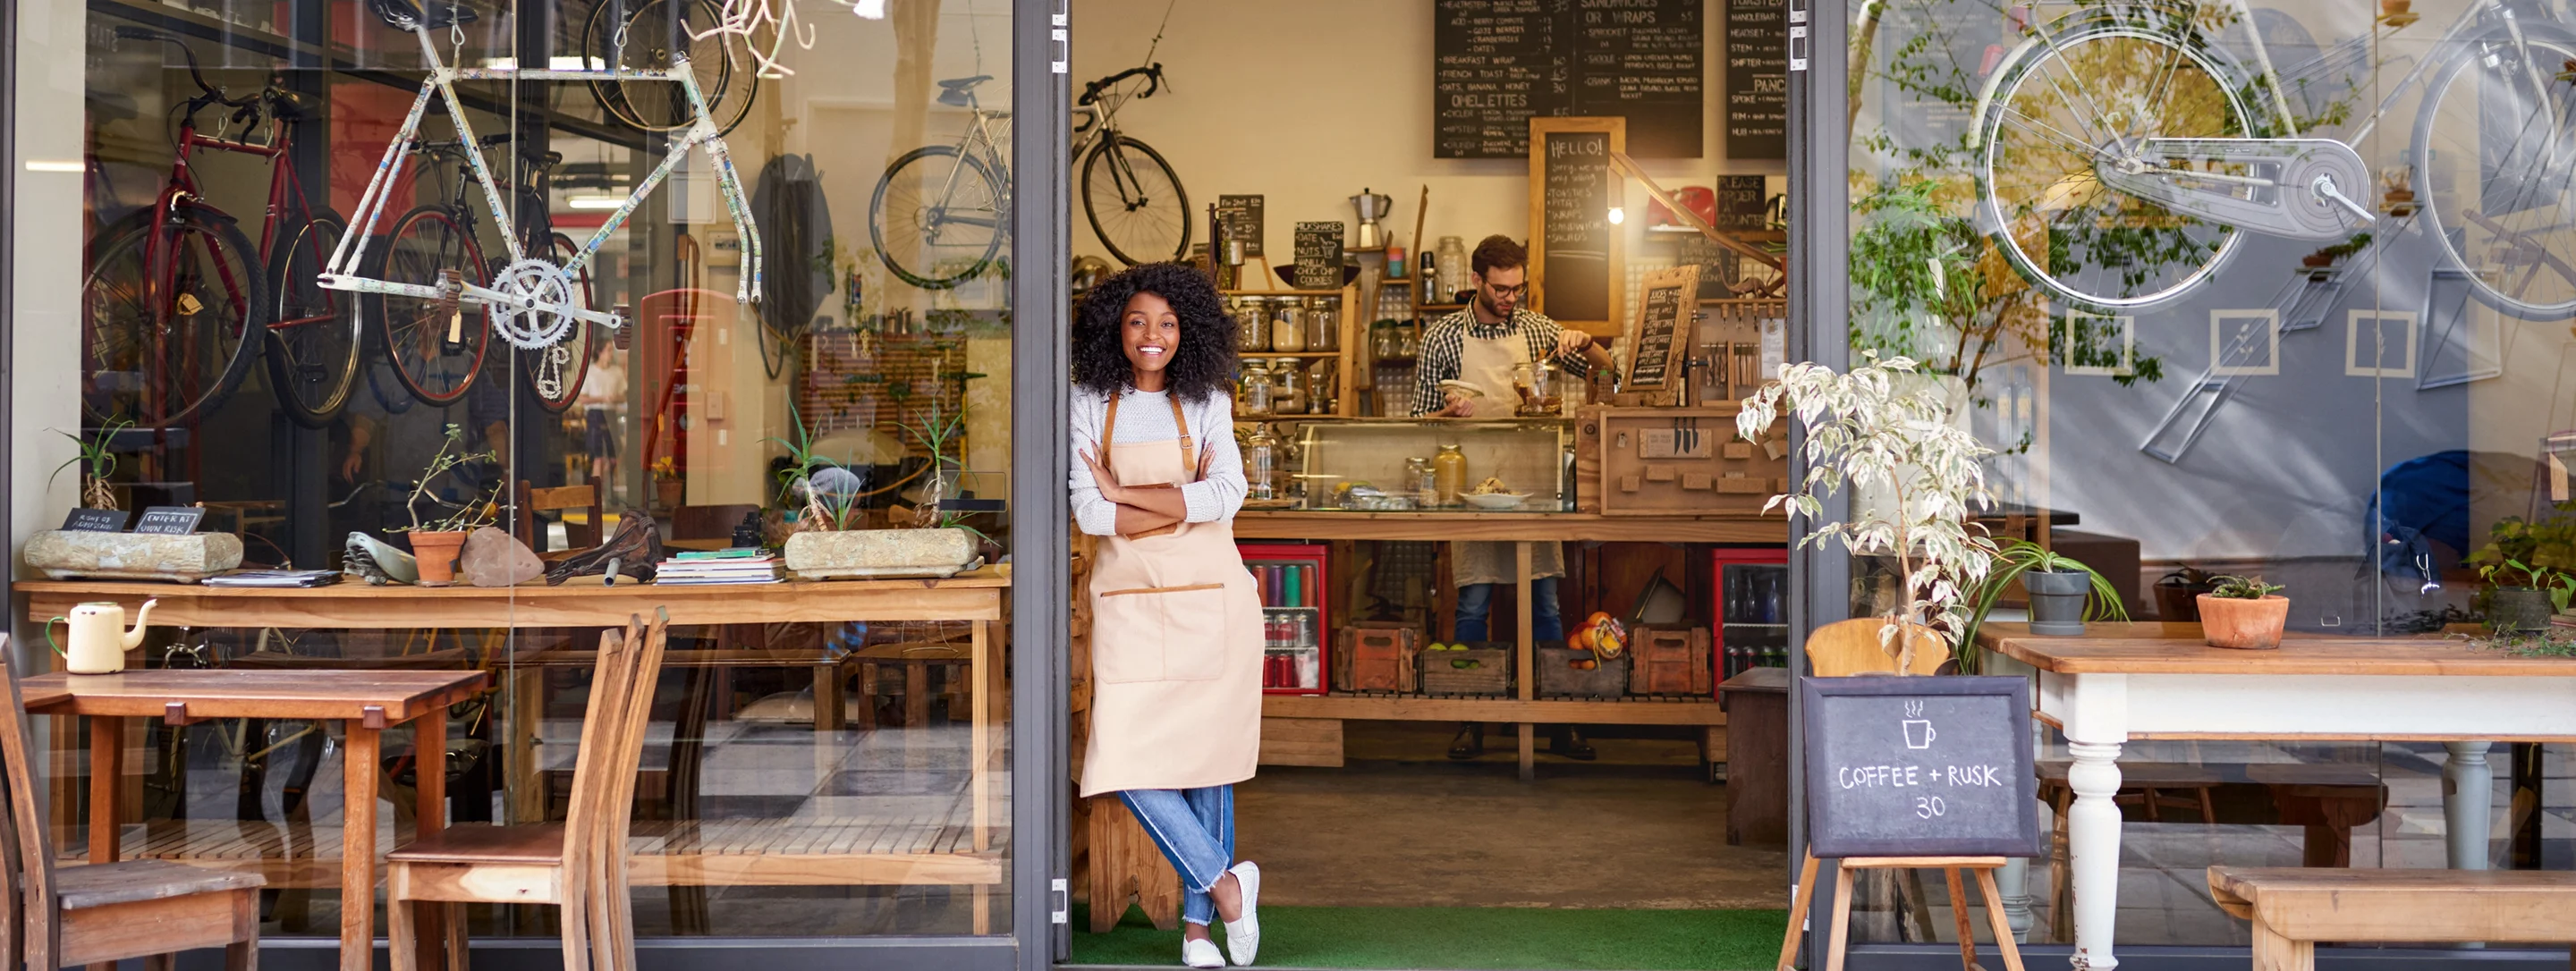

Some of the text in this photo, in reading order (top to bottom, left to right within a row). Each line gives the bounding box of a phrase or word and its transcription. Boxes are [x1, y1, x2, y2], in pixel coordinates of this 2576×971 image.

[1586, 11, 1602, 23] OR
[1612, 11, 1657, 23] WRAPS
[1731, 13, 1776, 22] HANDLEBAR
[1730, 28, 1765, 38] HEADSET
[1473, 45, 1496, 53] DATES
[1731, 43, 1753, 54] STEM
[1442, 55, 1486, 65] BREAKFAST
[1492, 56, 1516, 65] WRAP
[1442, 70, 1473, 79] FRENCH
[1479, 70, 1504, 79] TOAST
[1732, 95, 1757, 104] SPOKE
[1446, 109, 1474, 118] CYCLER
[1732, 112, 1747, 121] RIM
[1732, 128, 1748, 137] HUB
[1551, 138, 1603, 159] HELLO!
[1718, 177, 1760, 189] PLEASE
[1718, 190, 1757, 202] ORDER
[1552, 209, 1584, 220] WRAPS
[1718, 215, 1766, 228] COUNTER
[1296, 223, 1343, 231] MILKSHAKES
[1297, 232, 1318, 242] DATE
[1297, 246, 1320, 255] NUTS
[1298, 258, 1326, 267] VANILLA
[1300, 275, 1334, 285] COOKIES
[147, 514, 176, 522] ENTER
[140, 524, 185, 534] OWN RISK
[1839, 764, 2003, 789] COFFEE + RUSK
[1916, 796, 1946, 819] 30
